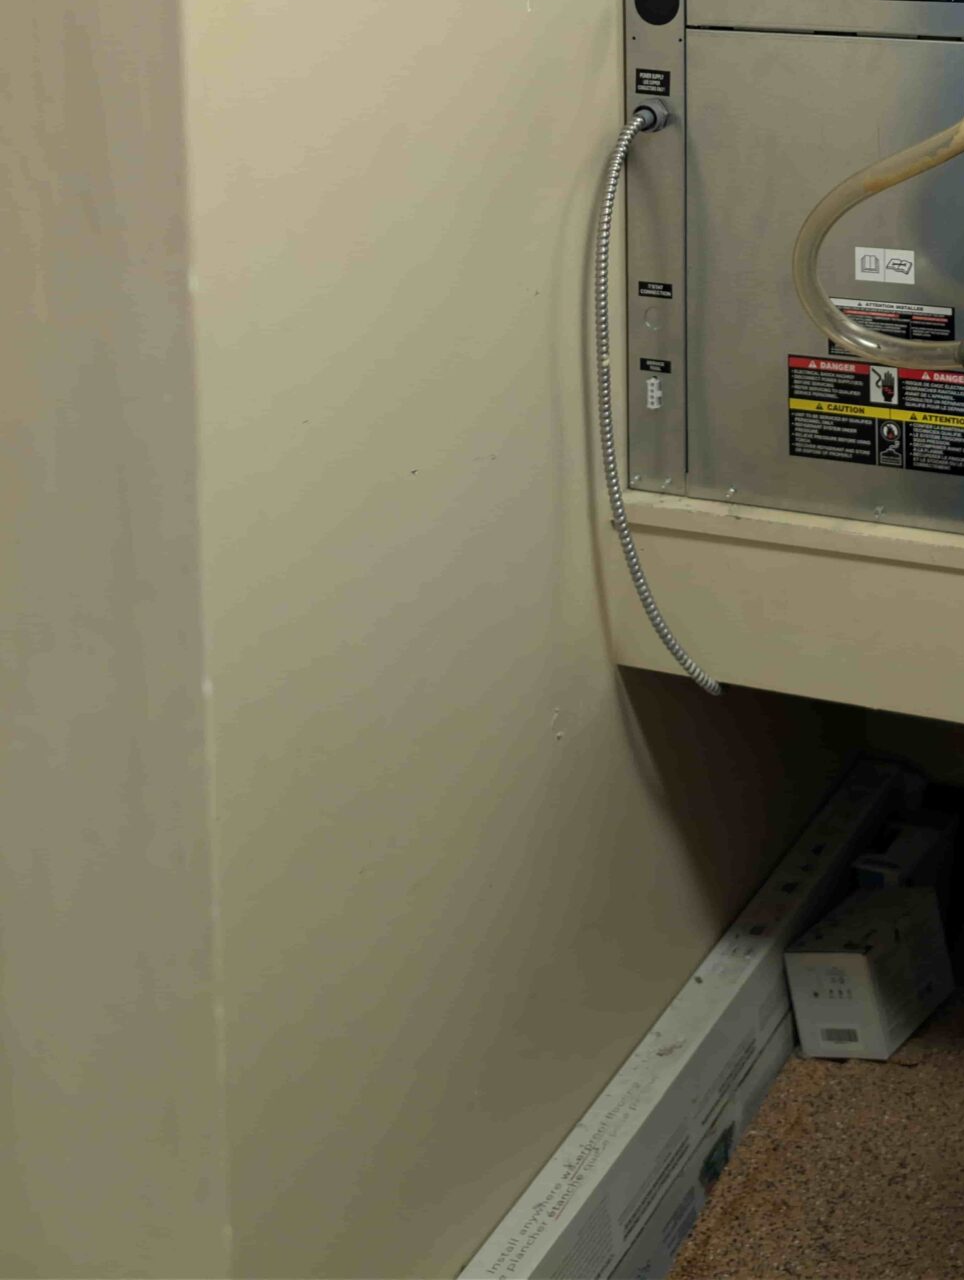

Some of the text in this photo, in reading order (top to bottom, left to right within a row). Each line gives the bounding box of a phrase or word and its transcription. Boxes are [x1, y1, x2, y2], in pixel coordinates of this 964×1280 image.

[821, 362, 855, 372] DANGER
[827, 404, 865, 414] CAUTION
[488, 1238, 519, 1274] Install
[507, 1221, 549, 1272] plancher
